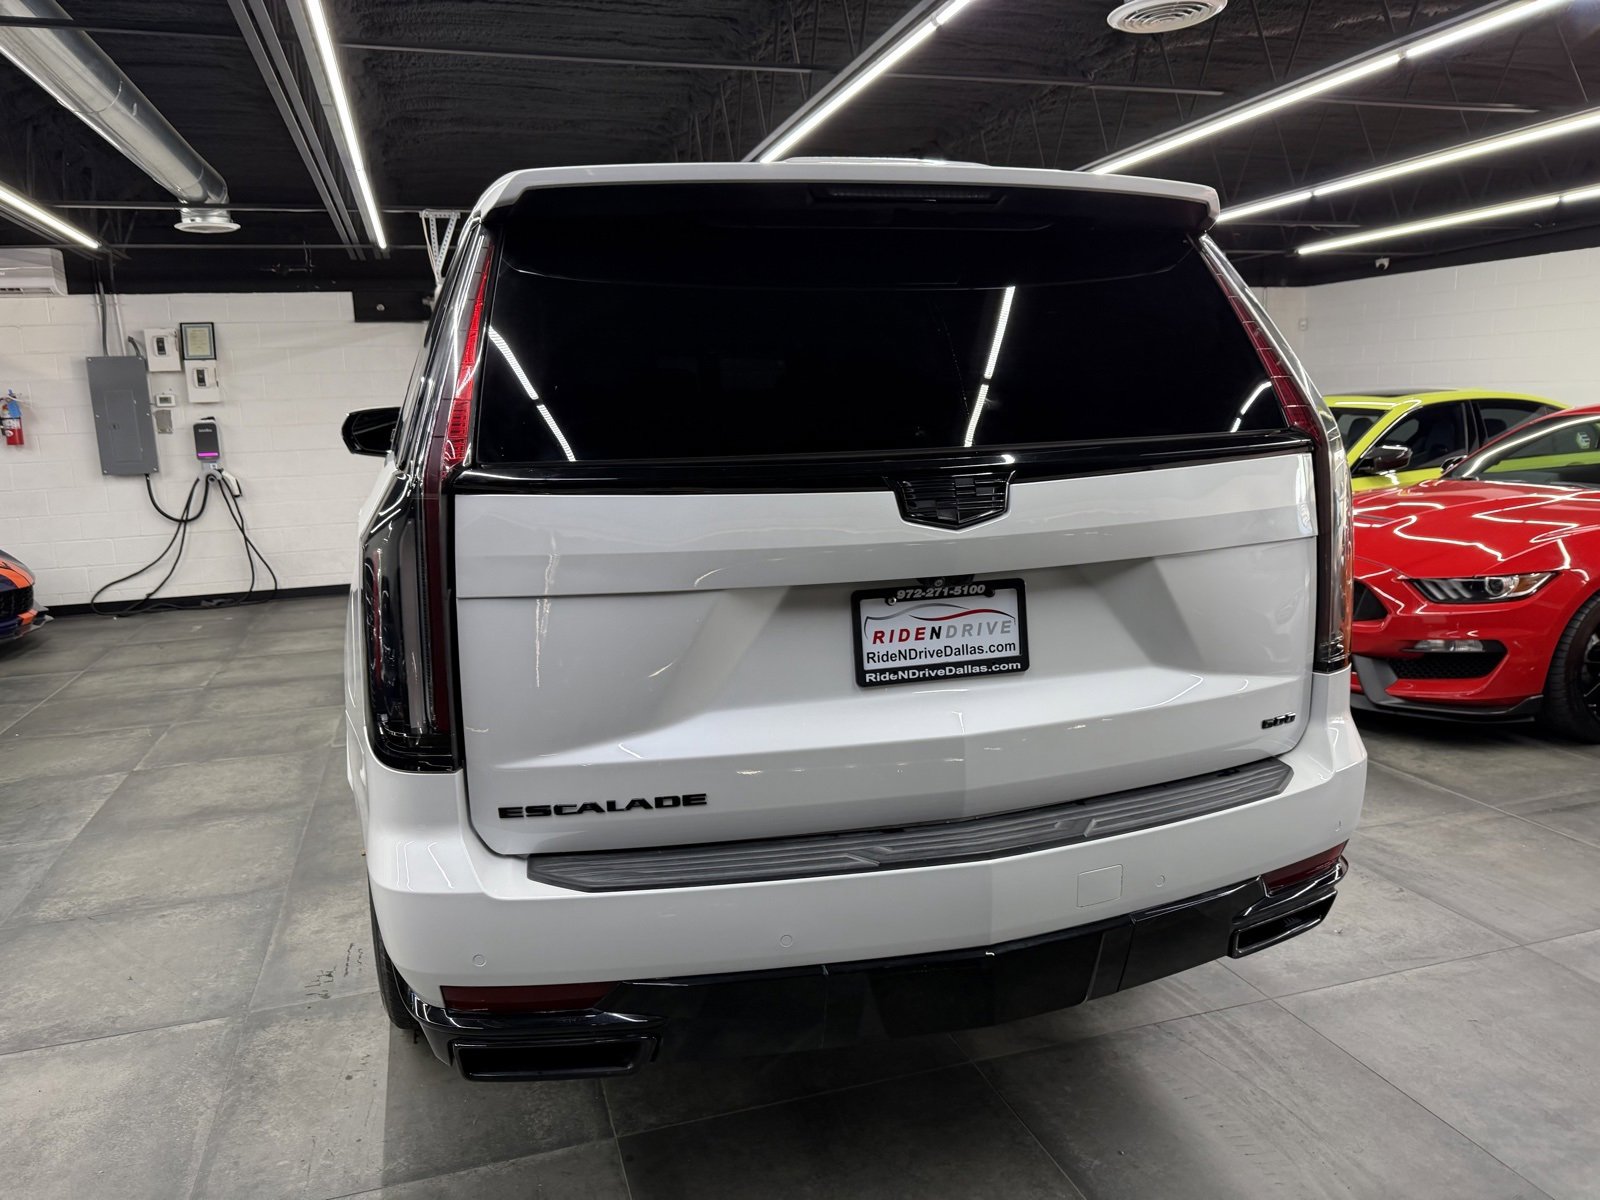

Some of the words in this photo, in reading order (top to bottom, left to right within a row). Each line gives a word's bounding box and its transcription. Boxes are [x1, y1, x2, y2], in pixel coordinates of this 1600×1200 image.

[896, 584, 986, 600] 972-271-5100
[866, 642, 1016, 664] RideNDriveDallas.com
[865, 661, 1021, 683] RideNDriveDallas.com
[498, 793, 707, 819] ESCALADE
